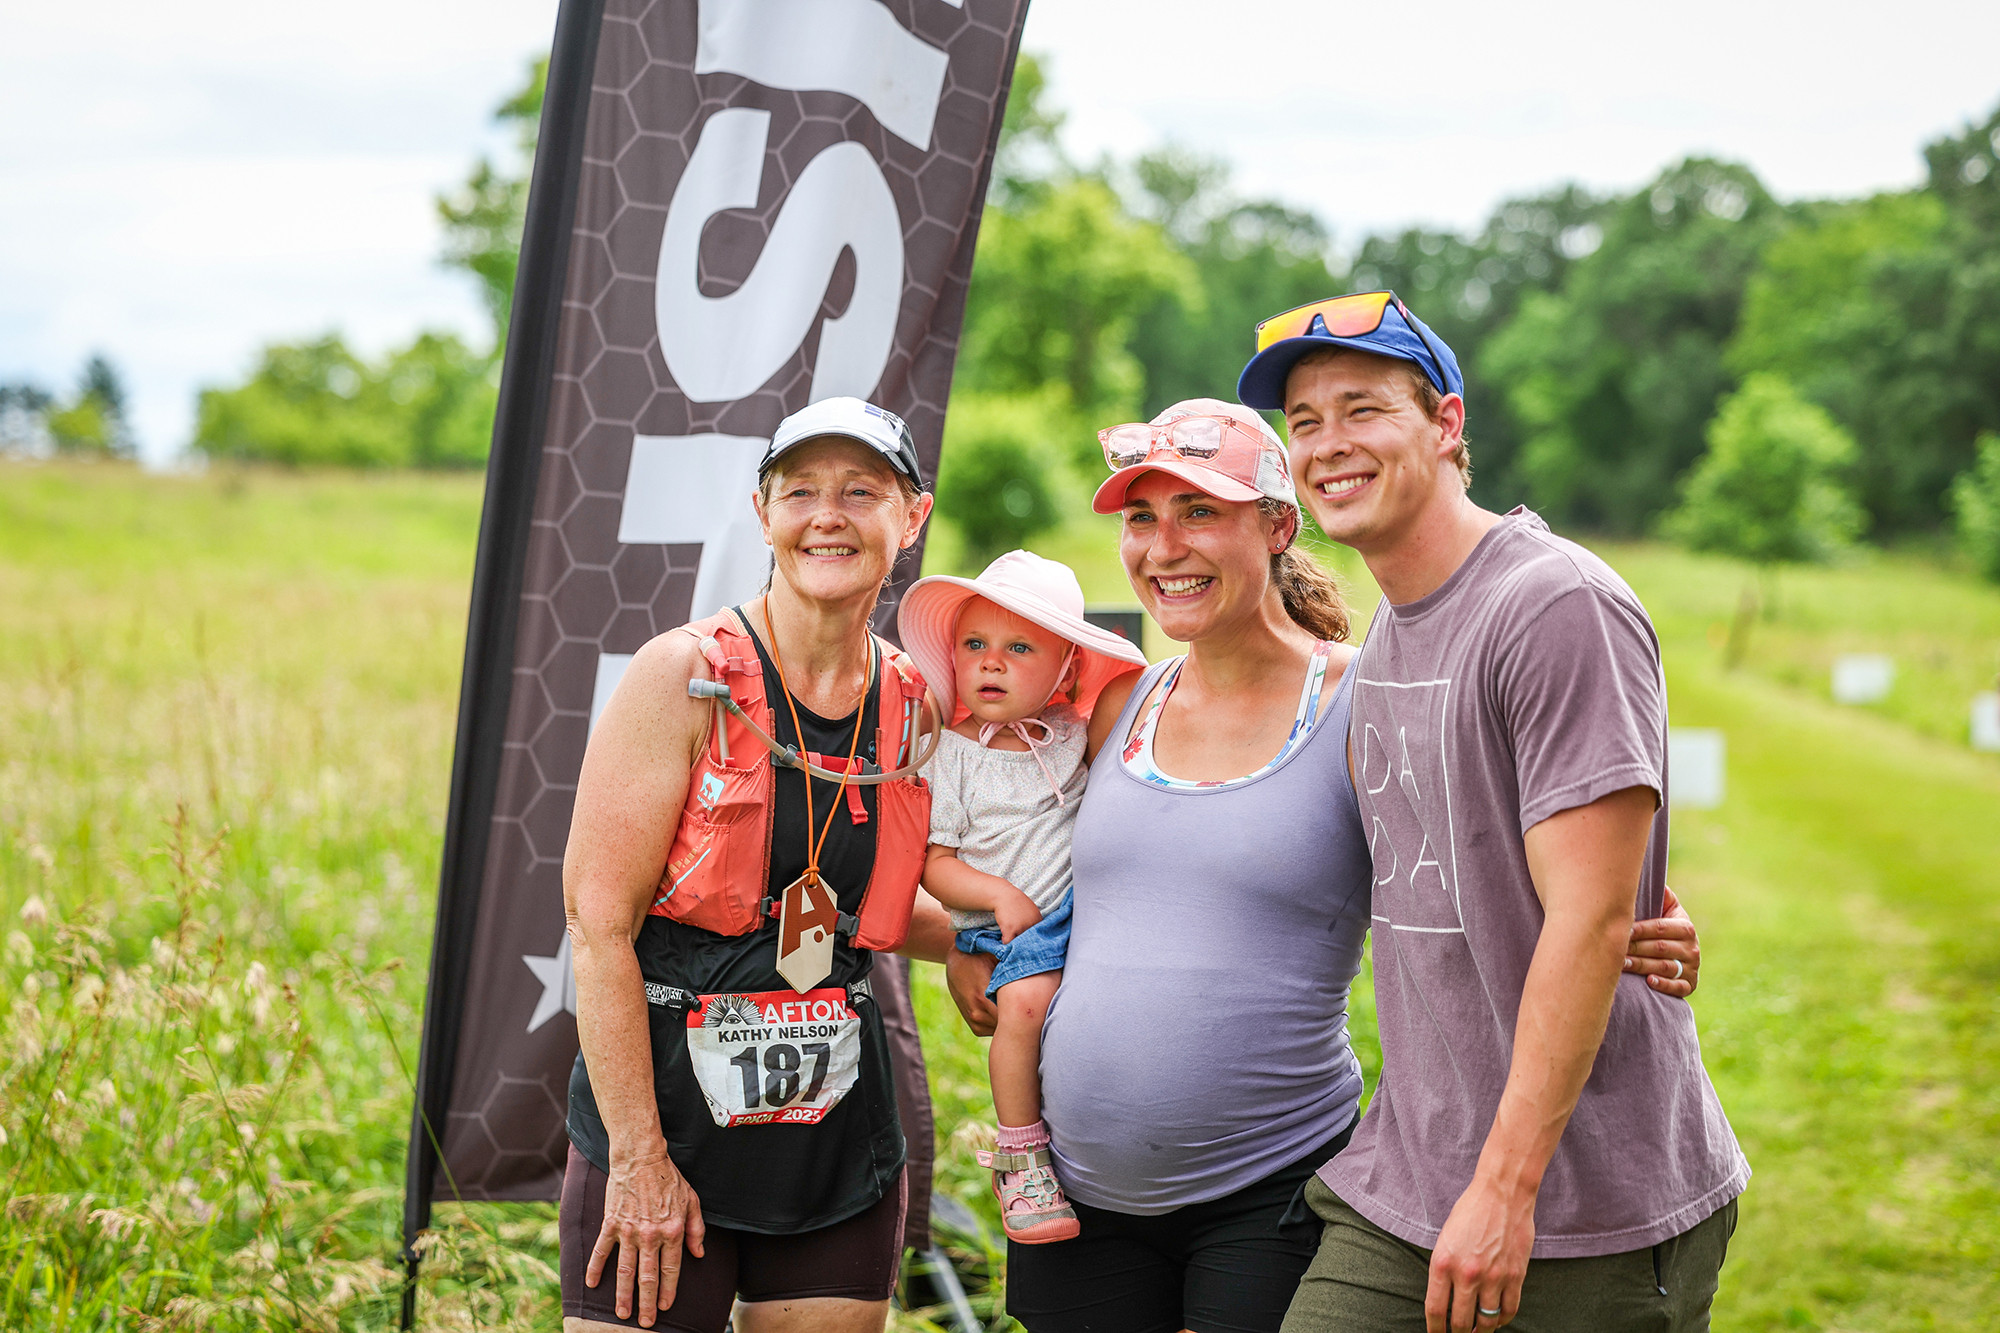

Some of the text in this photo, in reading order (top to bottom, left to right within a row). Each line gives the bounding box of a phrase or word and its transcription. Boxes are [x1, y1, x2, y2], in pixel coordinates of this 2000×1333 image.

[763, 1000, 847, 1024] AFTON
[718, 1025, 838, 1043] KATHY NELSON
[730, 1043, 831, 1109] 187
[781, 1109, 821, 1122] 2025
